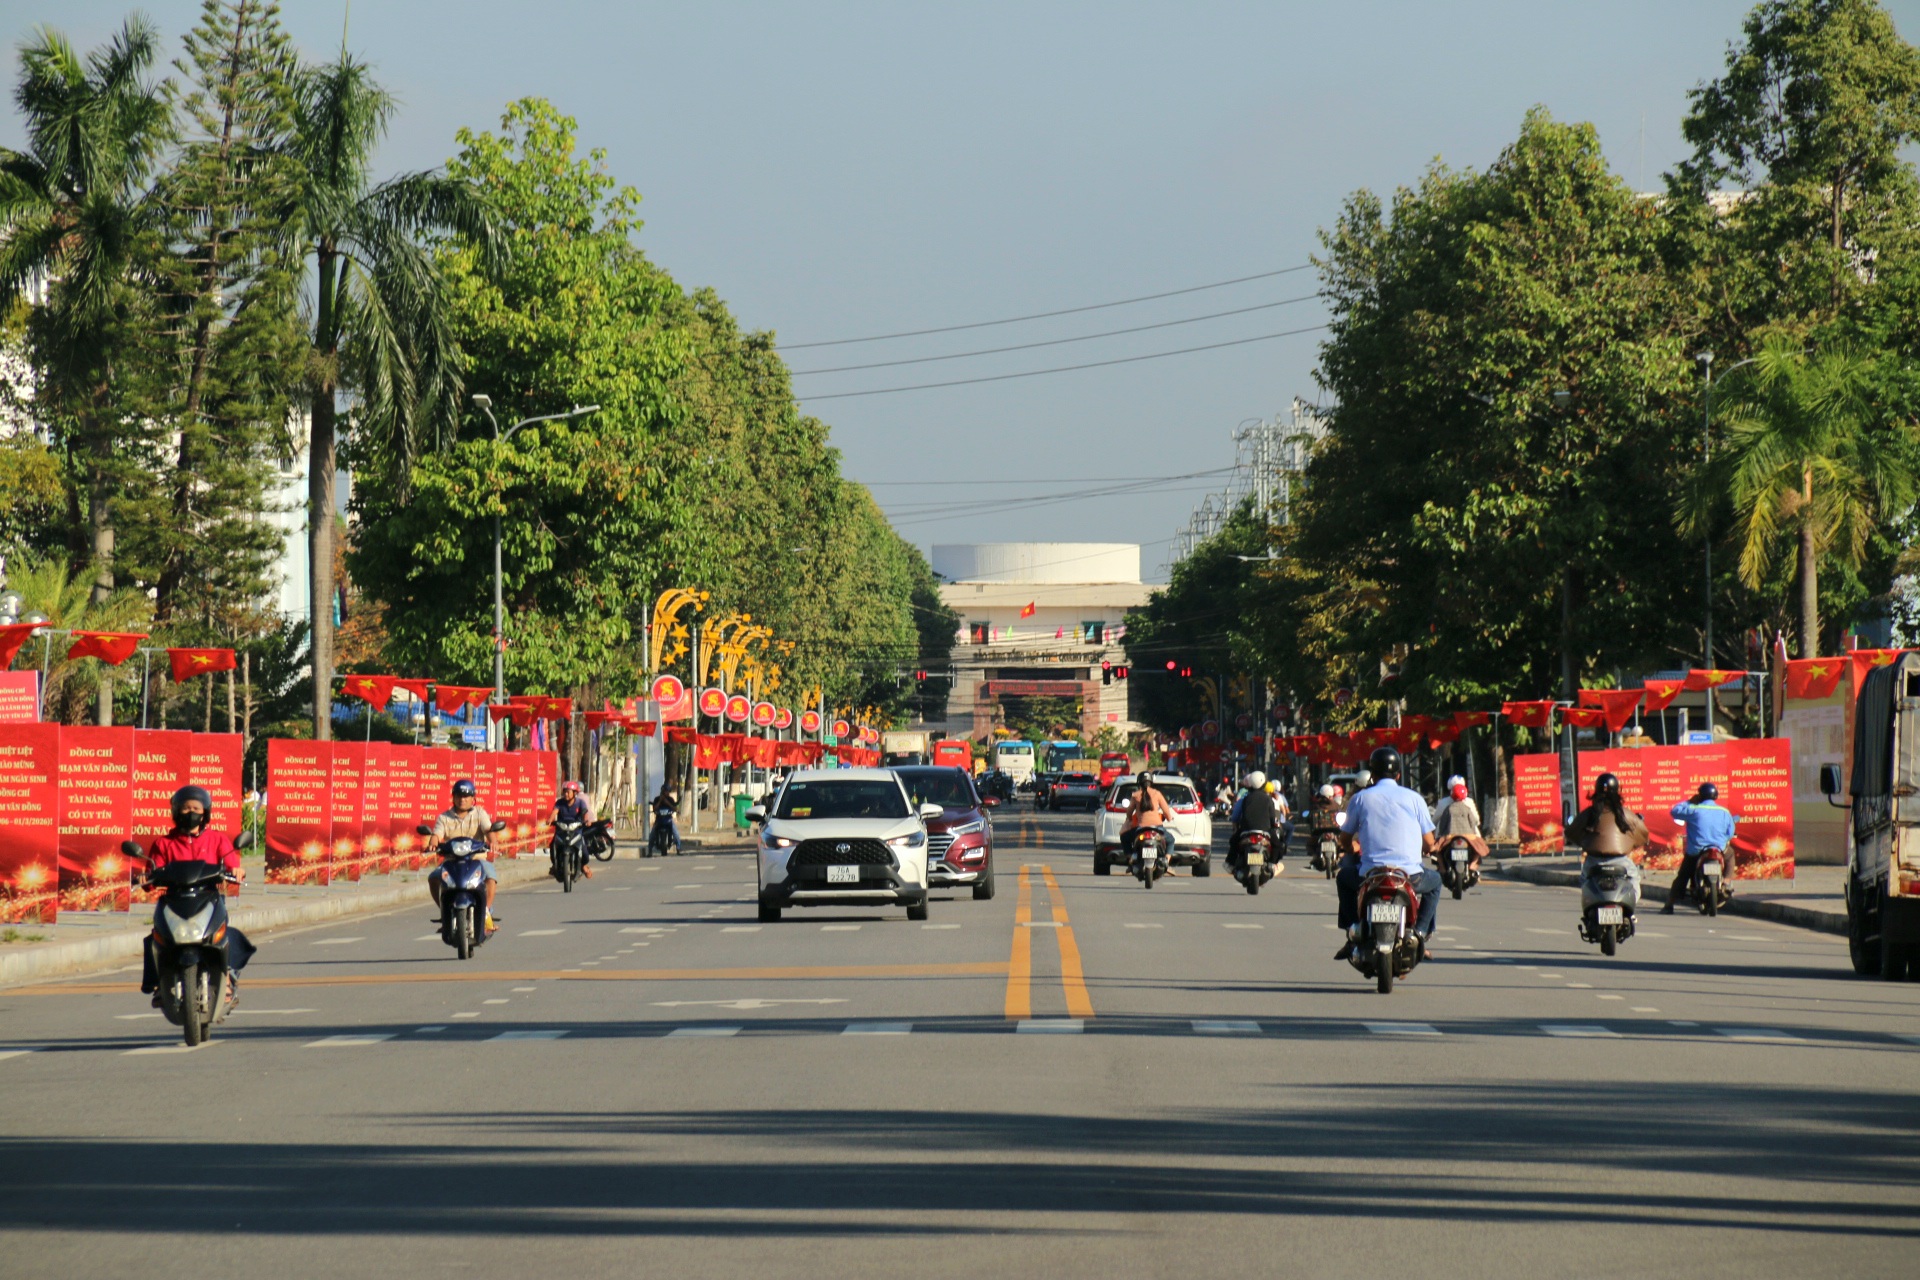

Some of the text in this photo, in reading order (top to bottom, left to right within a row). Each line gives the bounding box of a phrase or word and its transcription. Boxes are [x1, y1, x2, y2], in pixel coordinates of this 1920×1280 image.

[18, 745, 33, 757] LIỆT
[70, 747, 113, 757] ĐỒNG CHÍ
[138, 751, 166, 763] ĐẢNG
[191, 755, 205, 763] HỌC
[285, 755, 316, 764] ĐỒNG CHÍ
[1742, 756, 1775, 764] ĐỒNG CHÍ
[14, 761, 35, 769] MỪNG
[83, 763, 100, 772] VĂN
[102, 762, 127, 772] ĐỒNG
[133, 769, 177, 783] ỘNG SẢN
[274, 768, 326, 777] PHẠM VĂN ĐỒNG
[342, 769, 360, 777] ĐỒNG
[368, 769, 387, 777] ĐỒNG
[1732, 770, 1752, 778] PHẠM
[1768, 767, 1787, 775] ĐỒNG
[0, 774, 47, 783] ĂM NGÀY SINH
[209, 777, 221, 785] CHÍ
[1710, 774, 1728, 783] NIỆM
[59, 778, 127, 790] HÀ NGOẠI GIAO
[274, 780, 325, 789] NGƯỜI HỌC TRÒ
[345, 780, 358, 788] TRÒ
[1748, 781, 1769, 789] NGOẠI
[18, 788, 30, 797] CHÍ
[133, 788, 151, 801] IỆT
[284, 791, 315, 800] XUẤT SẮC
[1743, 792, 1755, 800] TÀI
[68, 794, 112, 805] TÀI NĂNG,
[7, 802, 41, 811] VĂN ĐỒNG
[276, 803, 289, 811] CỦA
[339, 804, 354, 812] TỊCH
[1744, 804, 1753, 812] CÓ
[68, 809, 112, 819] CÓ UY TÍN
[276, 815, 286, 823] HỒ
[287, 815, 299, 824] CHÍ
[1740, 815, 1753, 823] RÊN
[82, 824, 100, 834] THẾ
[102, 825, 124, 834] GIỚI!
[132, 824, 151, 835] UÔN
